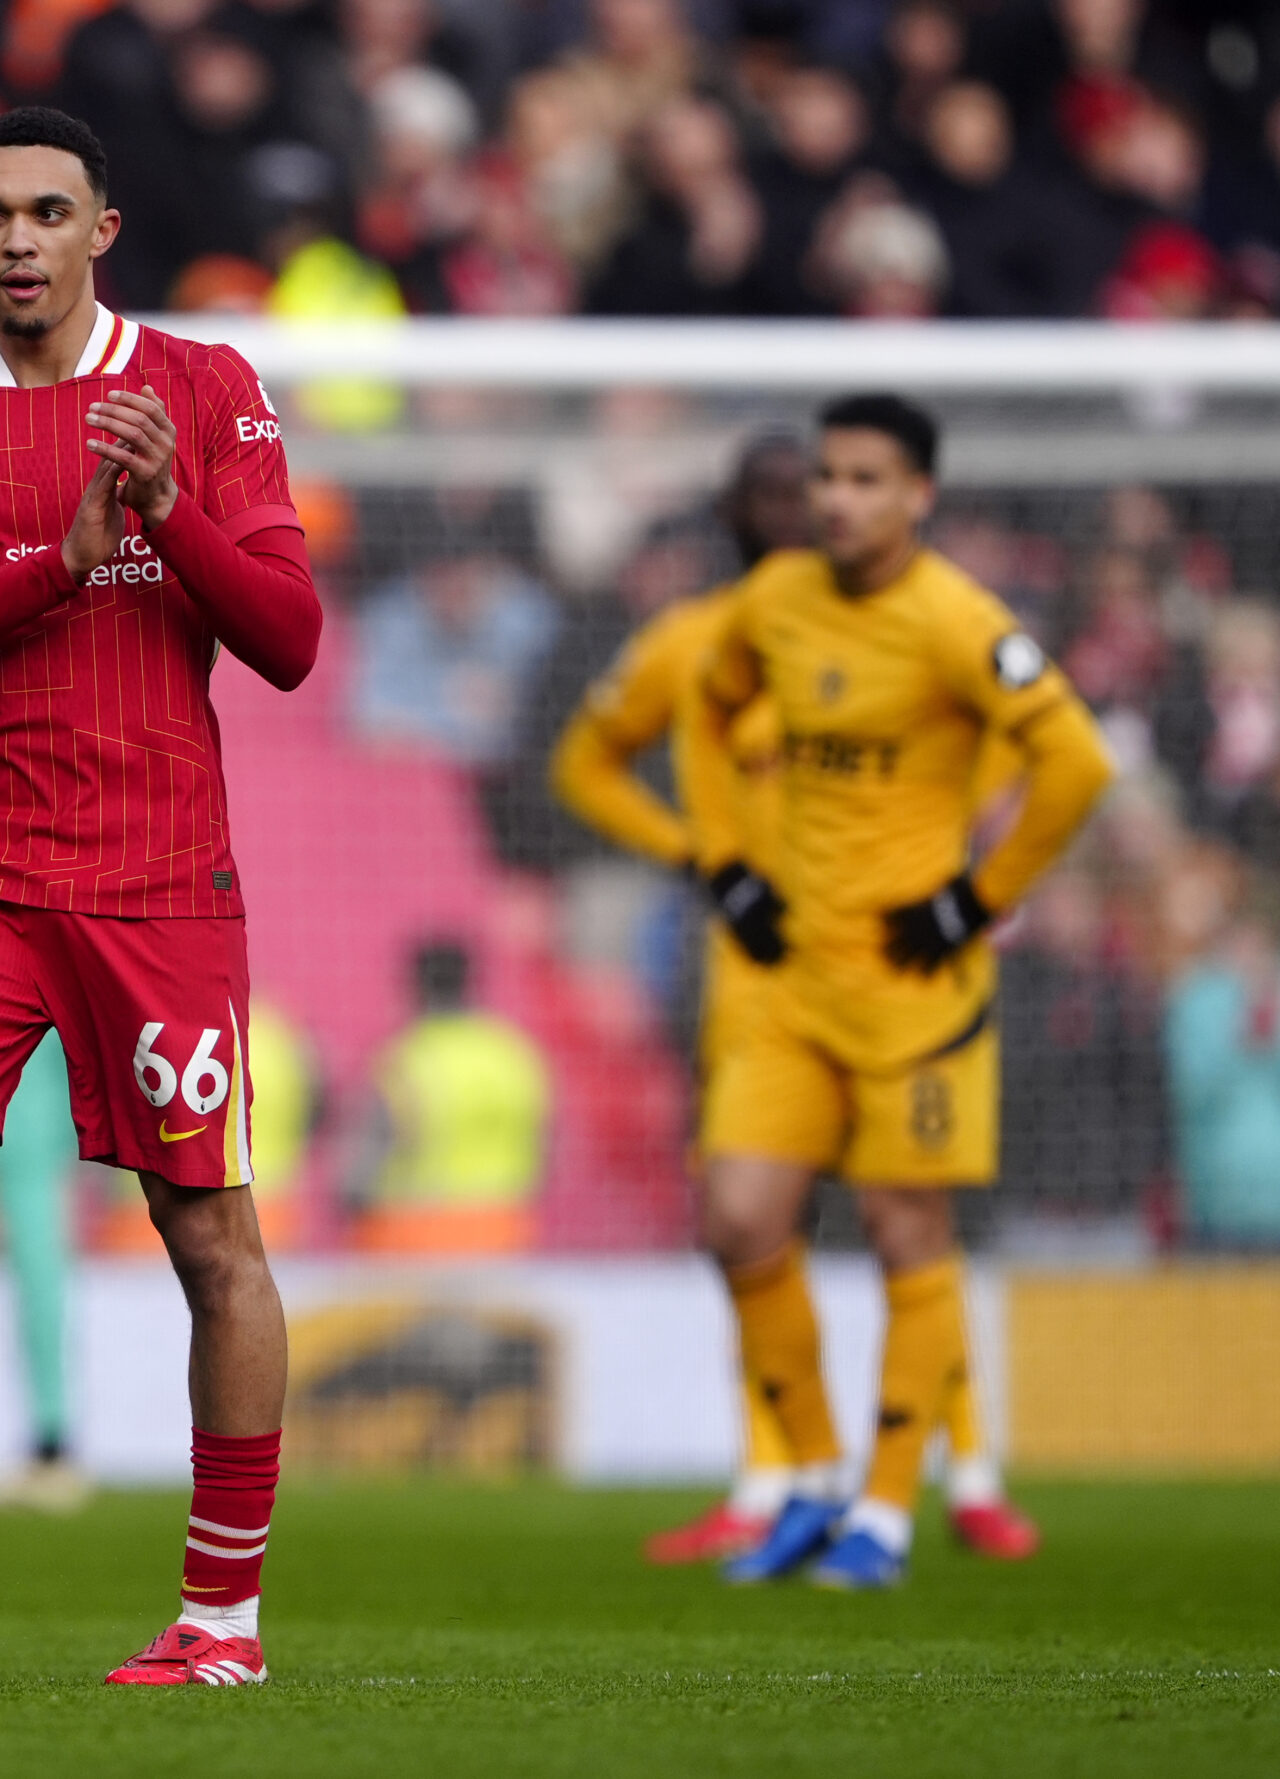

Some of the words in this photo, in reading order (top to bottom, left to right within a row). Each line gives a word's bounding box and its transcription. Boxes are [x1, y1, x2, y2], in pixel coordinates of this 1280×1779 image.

[236, 416, 282, 443] Exp
[85, 556, 163, 586] ered
[133, 1022, 228, 1115] 66
